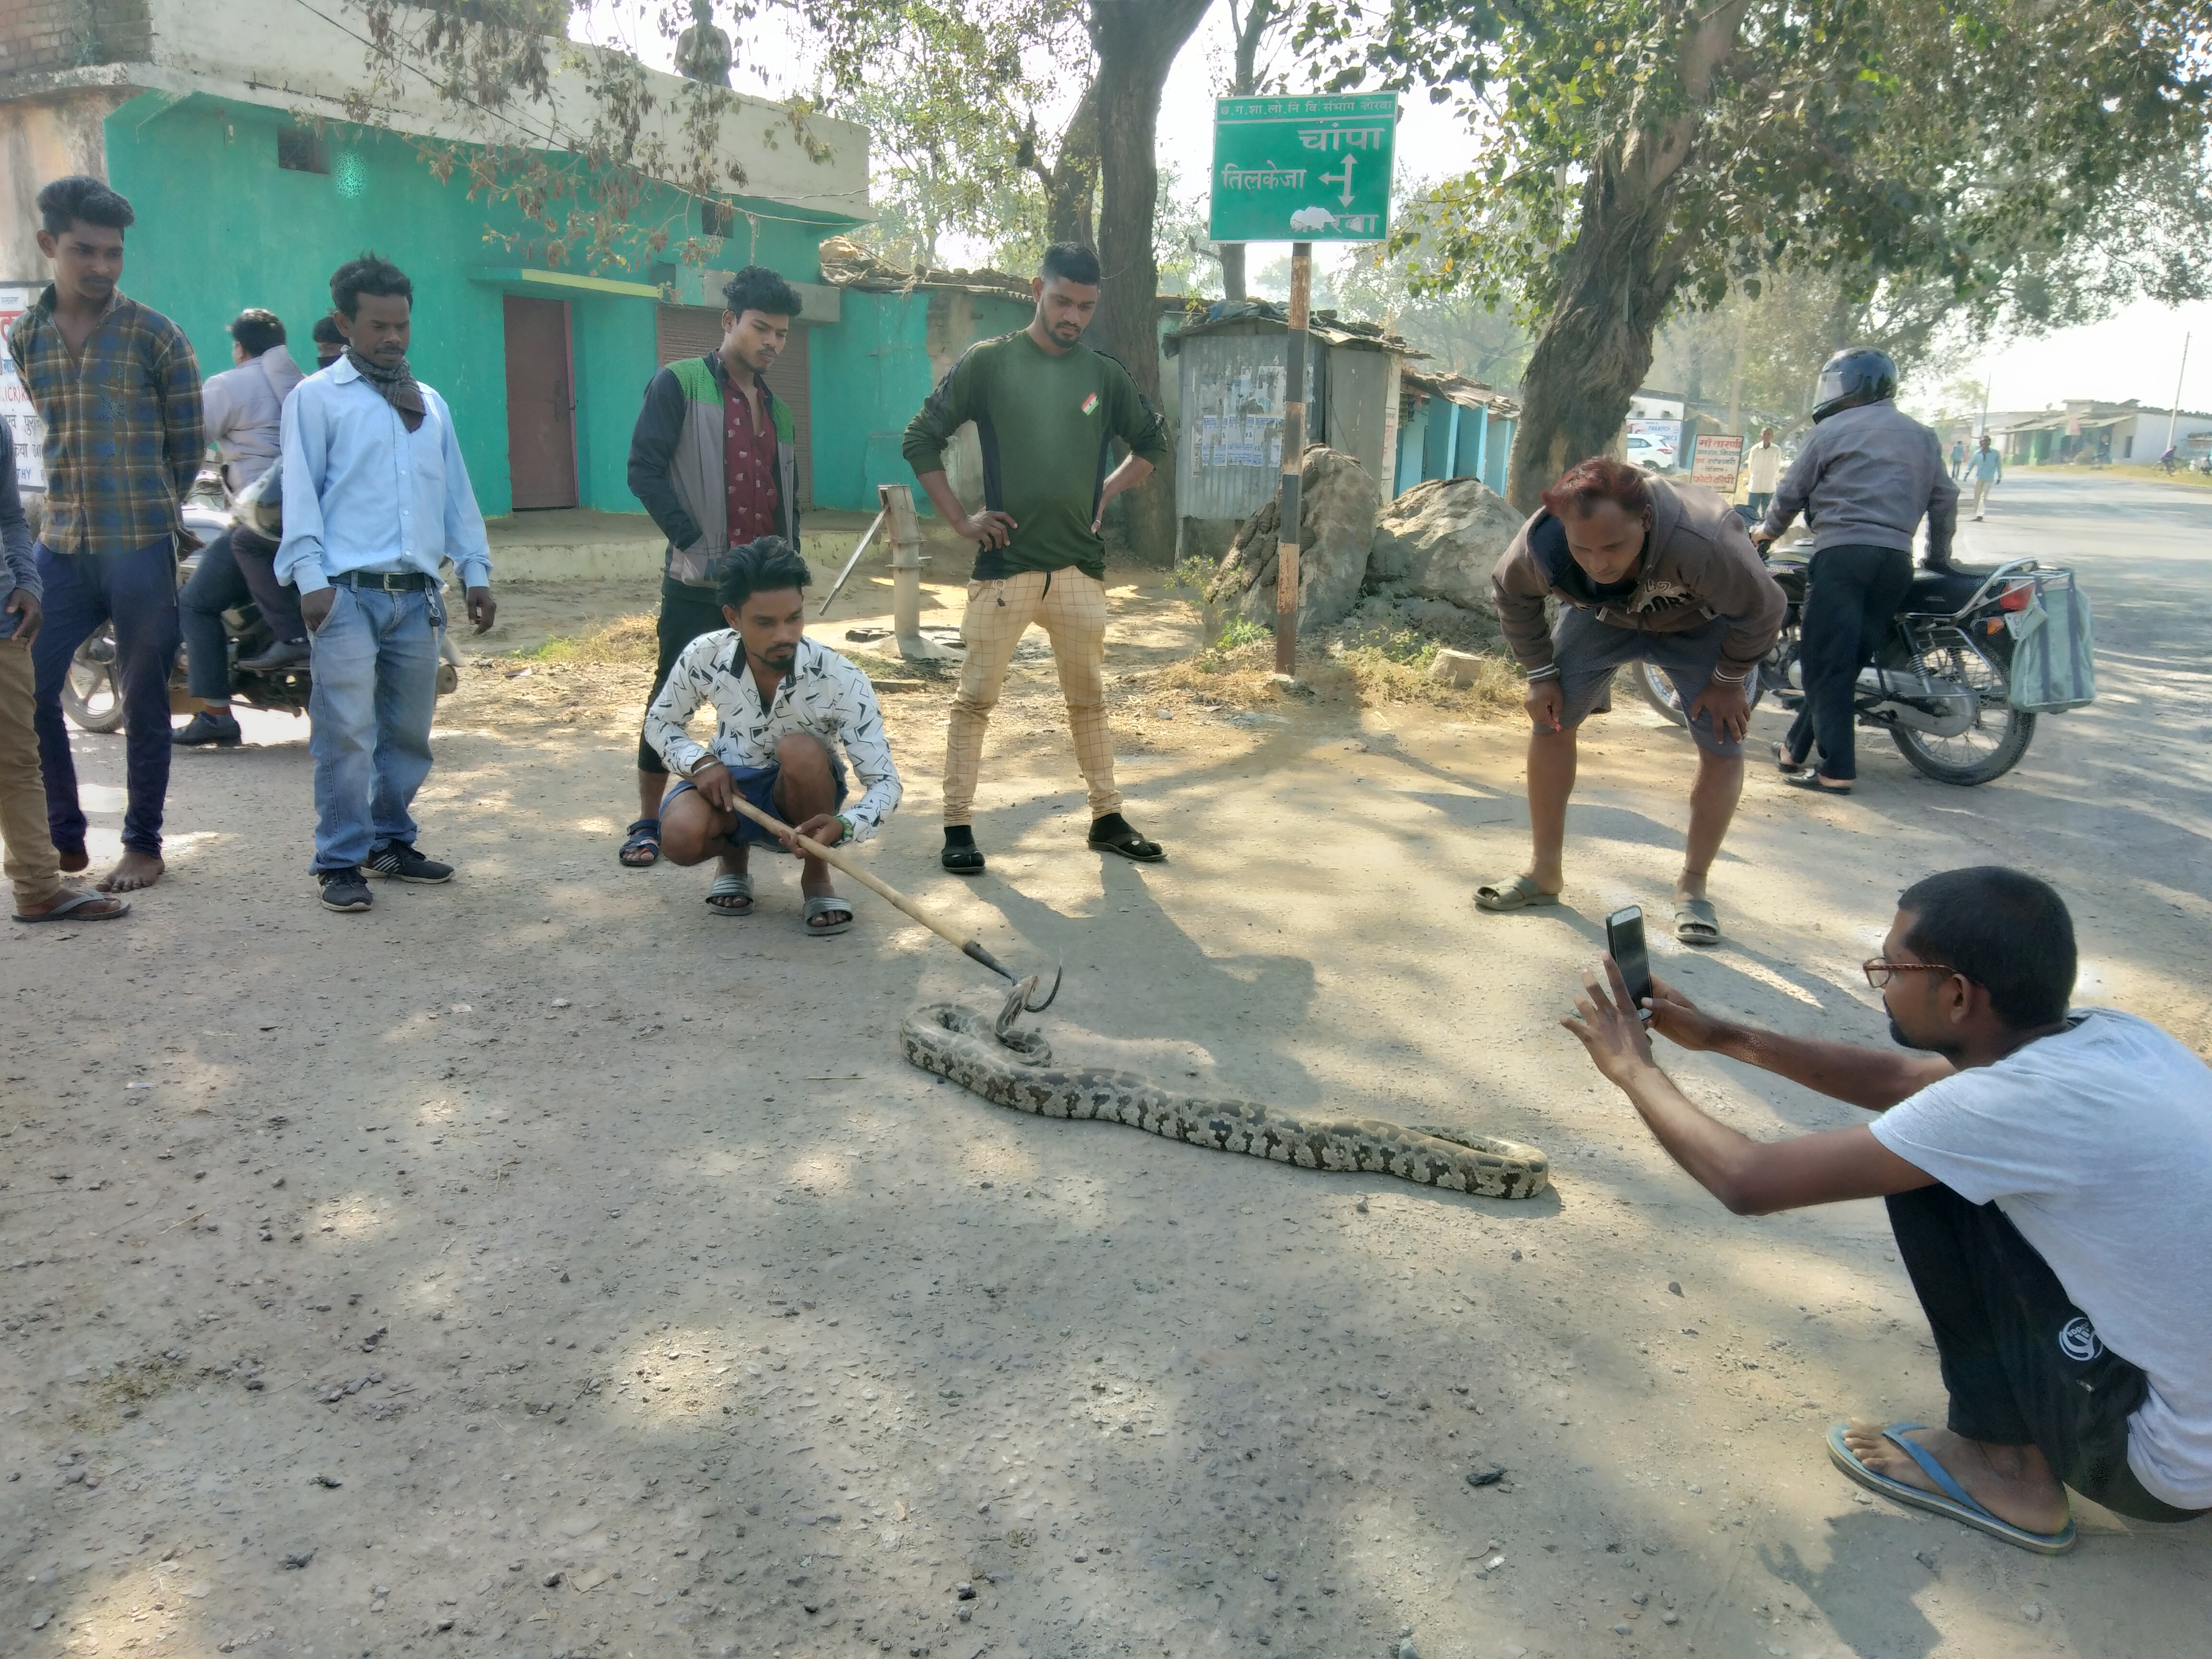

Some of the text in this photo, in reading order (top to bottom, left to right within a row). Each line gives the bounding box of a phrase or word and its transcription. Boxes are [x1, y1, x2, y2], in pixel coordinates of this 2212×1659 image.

[1323, 101, 1355, 112] संभाग
[1297, 122, 1385, 151] चांपा
[1221, 159, 1307, 191] तिलकेजा
